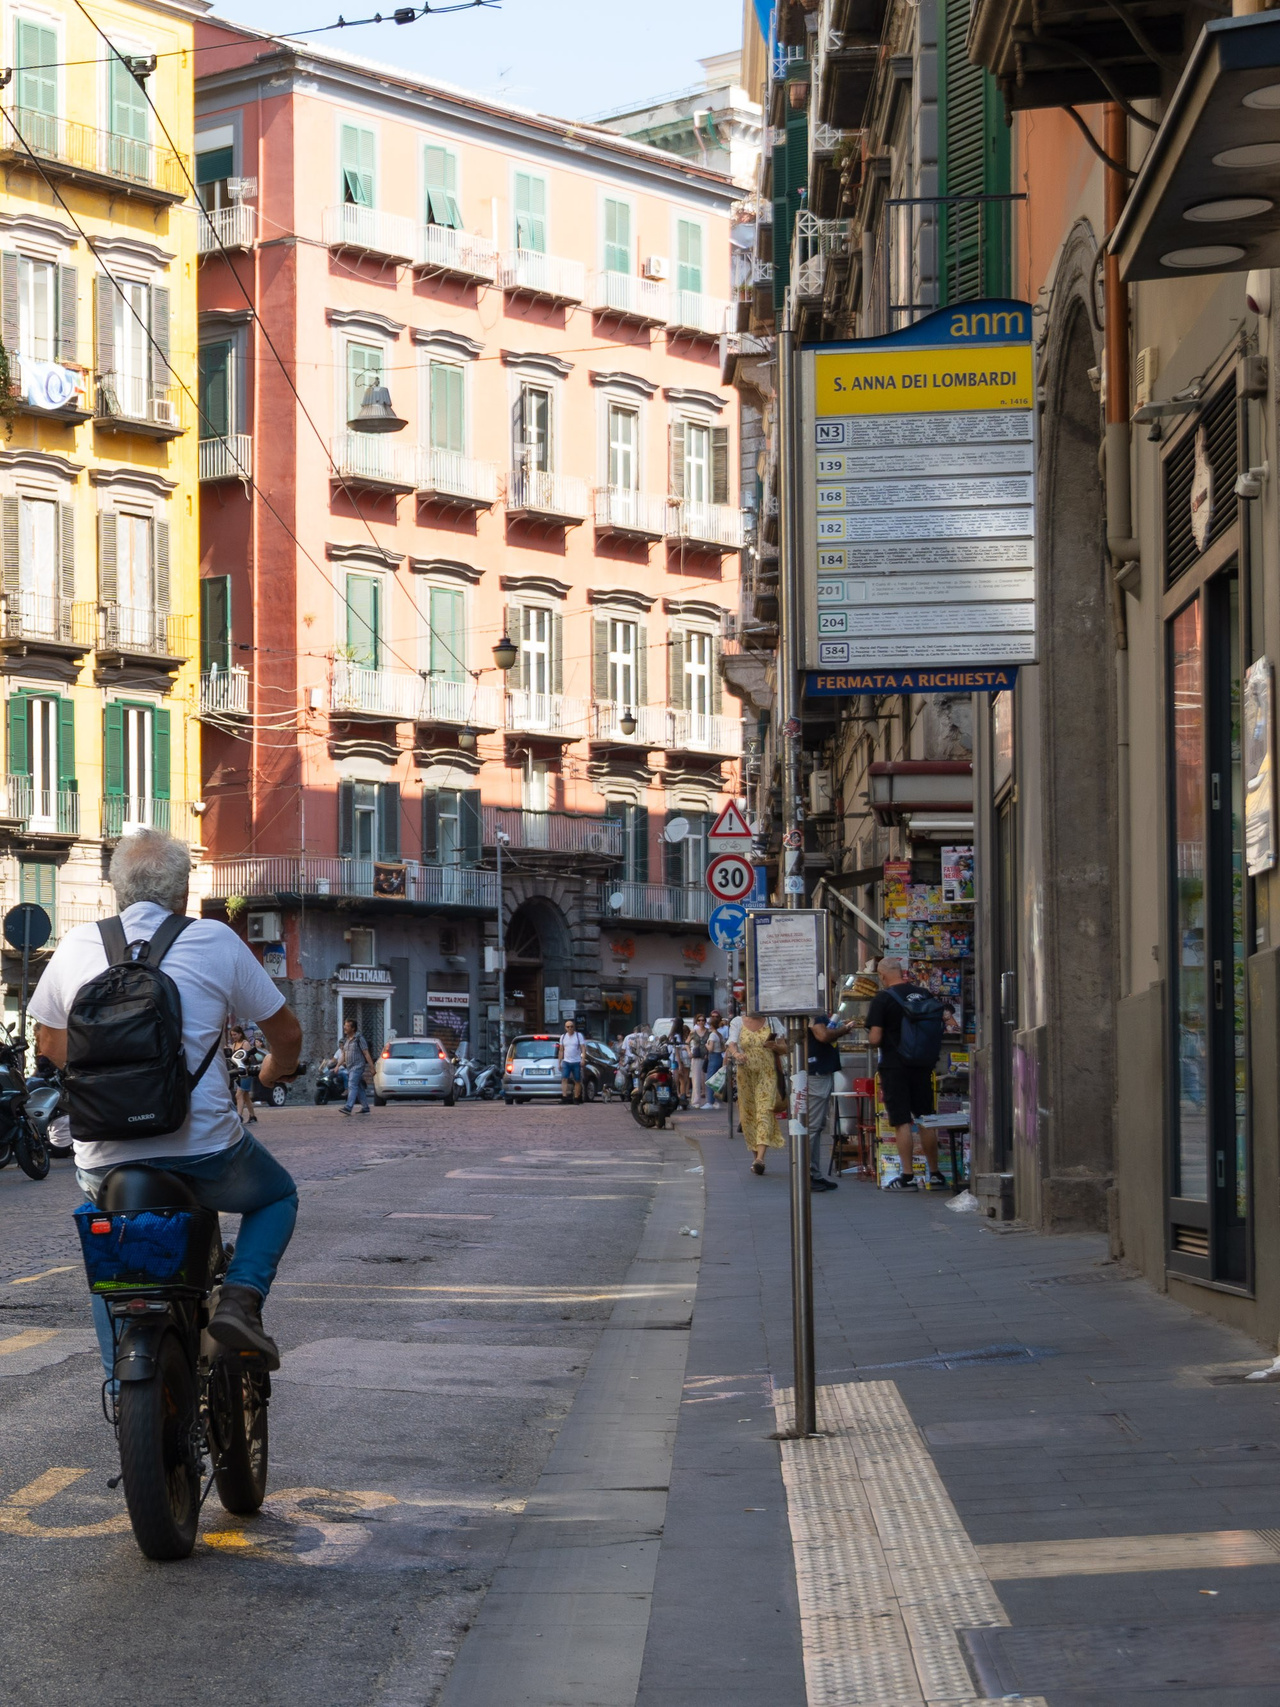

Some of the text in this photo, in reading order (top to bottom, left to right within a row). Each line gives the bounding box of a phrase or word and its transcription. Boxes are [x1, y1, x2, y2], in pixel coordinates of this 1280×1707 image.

[950, 311, 1023, 337] anm
[834, 371, 1016, 392] S. ANNA DEI LOMBARDI
[820, 426, 840, 438] N3
[820, 461, 842, 471] 139
[820, 492, 842, 502] 168
[820, 524, 842, 533] 182
[820, 555, 843, 565] 184
[817, 586, 840, 595] 201
[822, 618, 844, 627] 204
[825, 646, 845, 655] 584
[817, 672, 1008, 689] FERMATA A RICHIESTA
[718, 867, 744, 888] 30
[340, 968, 391, 983] OUTLETMANIA
